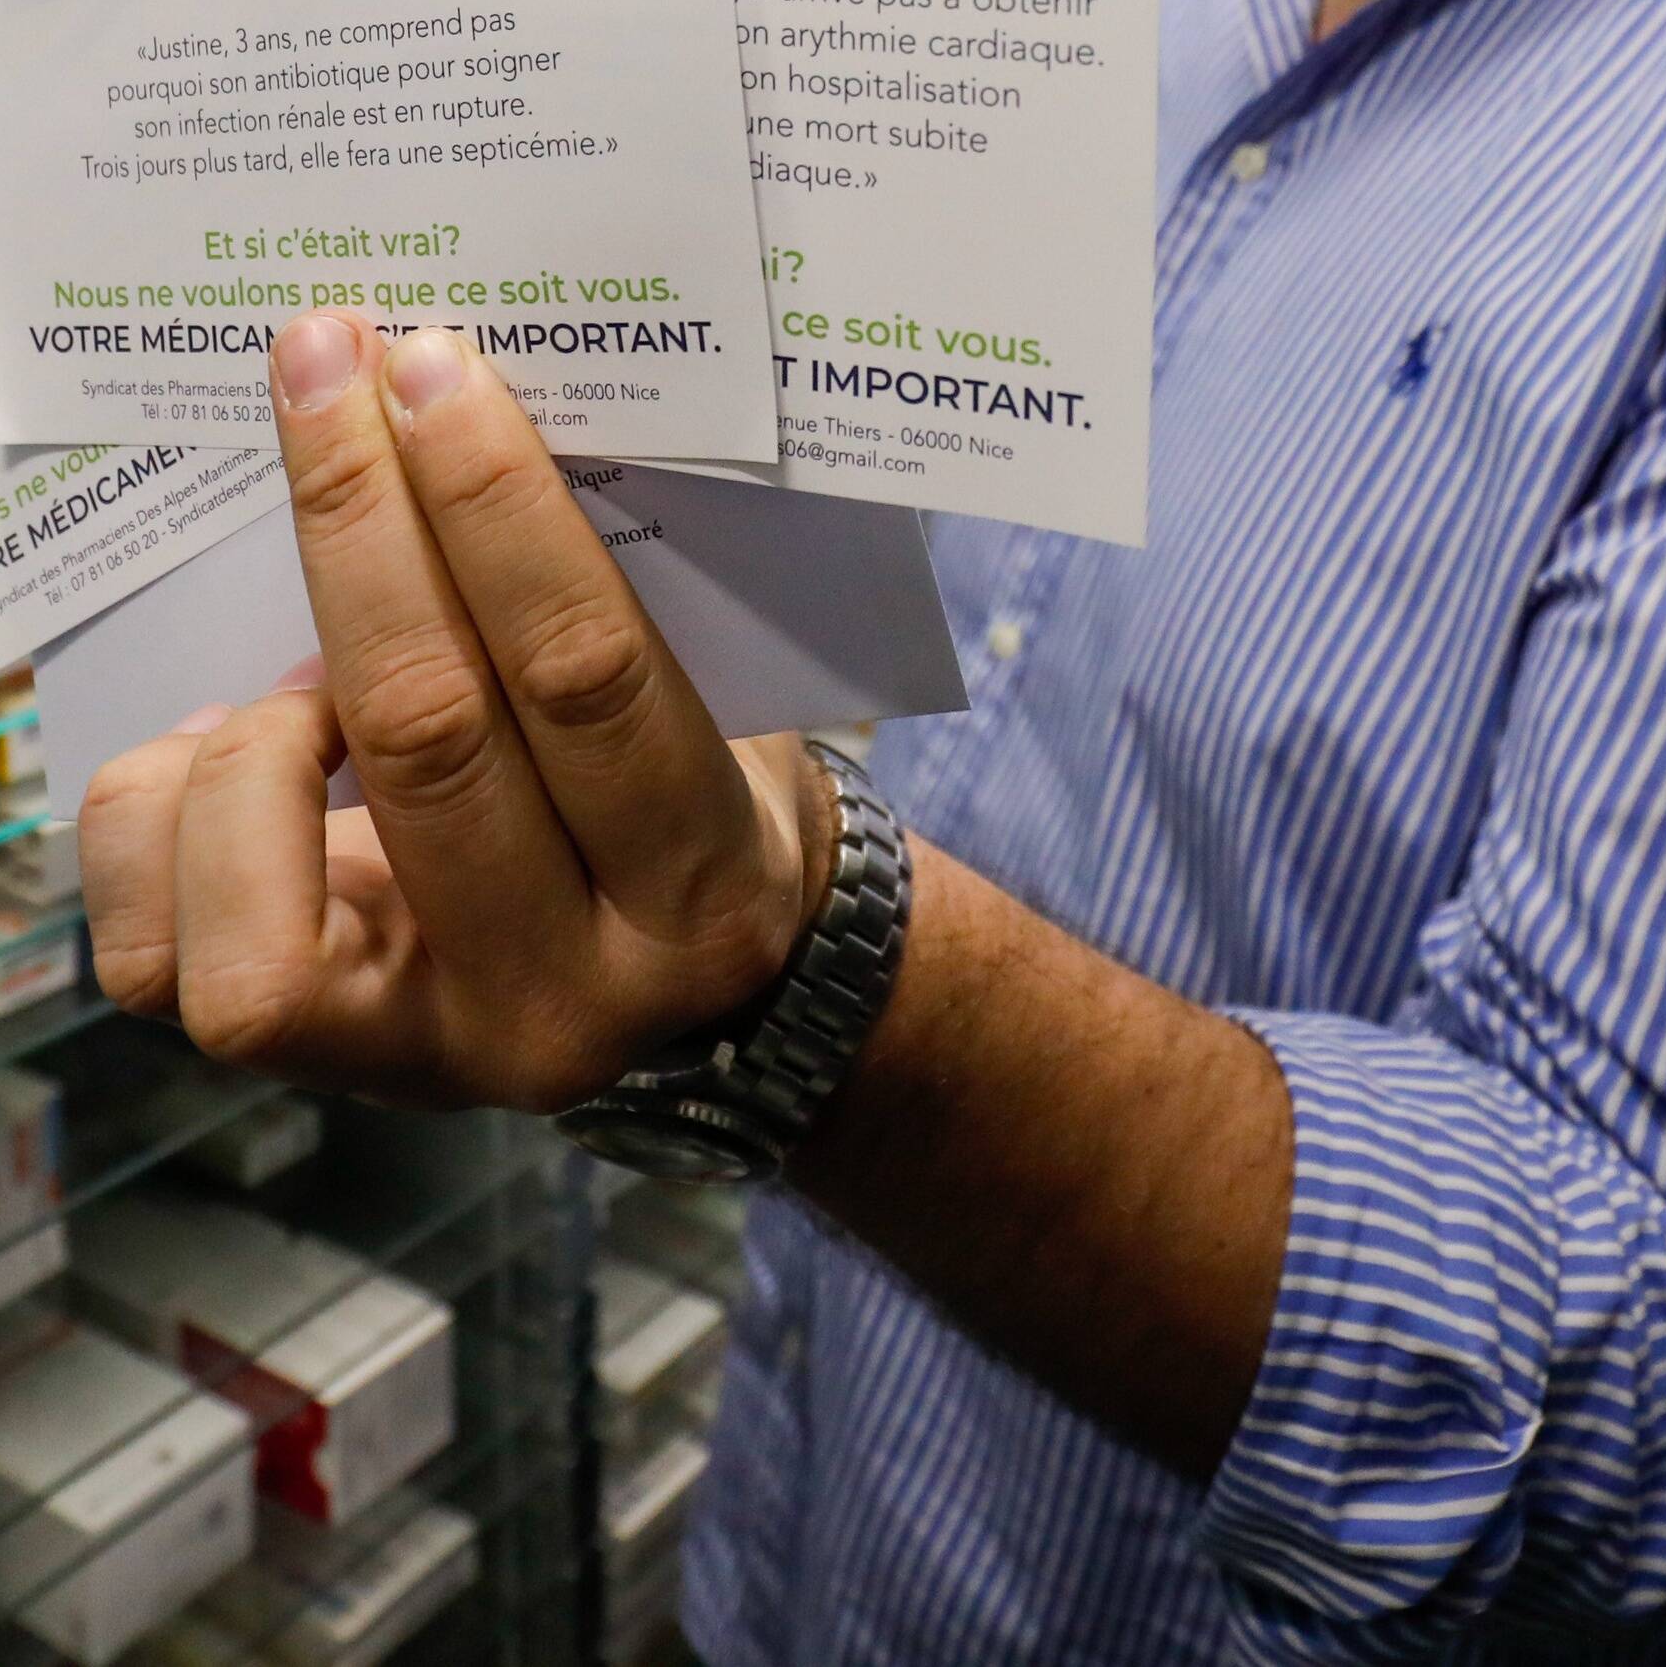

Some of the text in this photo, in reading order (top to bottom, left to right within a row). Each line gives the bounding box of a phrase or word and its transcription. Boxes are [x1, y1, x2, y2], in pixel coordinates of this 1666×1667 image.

[137, 7, 516, 61] «Justine, 3 ans, ne comprend pas
[736, 20, 1105, 70] on arythmie cardiaque.
[107, 49, 561, 109] pourquoi son antibiotique pour soigner
[740, 64, 1021, 108] on hospitalisation
[134, 96, 533, 139] son infection rénale est en rupture.
[806, 117, 878, 145] mort
[889, 119, 988, 154] subite
[81, 130, 618, 184] Trois jours plus tard, elle fera une septicémie.»
[749, 152, 877, 191] diaque.»
[205, 223, 460, 260] Et si c'était vrai?
[54, 270, 680, 314] Nous ne voulons pas que ce soit vous.
[29, 325, 132, 353] VOTRE
[476, 321, 722, 355] IMPORTANT.
[782, 310, 1052, 367] ce soit vous.
[82, 379, 137, 399] Syndicat
[141, 380, 165, 396] des
[168, 381, 251, 398] Pharmaciens
[256, 382, 273, 397] De
[507, 383, 548, 400] hiers
[562, 384, 615, 401] 06000
[621, 384, 660, 401] Nice
[812, 359, 1091, 430] IMPORTANT.
[141, 404, 160, 420] Tél
[171, 405, 187, 420] 07
[192, 405, 207, 421] 81
[212, 405, 229, 421] 06
[233, 406, 250, 422] 50
[254, 406, 271, 422] 20
[528, 408, 588, 427] ail.com
[777, 438, 926, 476] s06@gmail.com
[824, 417, 882, 443] Thiers
[901, 427, 962, 453] 06000
[969, 437, 1014, 460] Nice
[15, 474, 47, 509] ne
[564, 467, 624, 492] lique
[39, 564, 61, 585] des
[62, 520, 136, 570] Pharmaciens
[136, 504, 162, 526] Des
[163, 482, 198, 511] Alpes
[198, 449, 259, 488] Maritimes
[44, 586, 63, 608] Tél
[71, 573, 88, 592] 07
[89, 563, 104, 583] 81
[107, 554, 124, 574] 06
[125, 543, 142, 562] 50
[143, 531, 160, 551] 20
[169, 456, 285, 535] Syndicatdespharma
[600, 519, 663, 547] onoré
